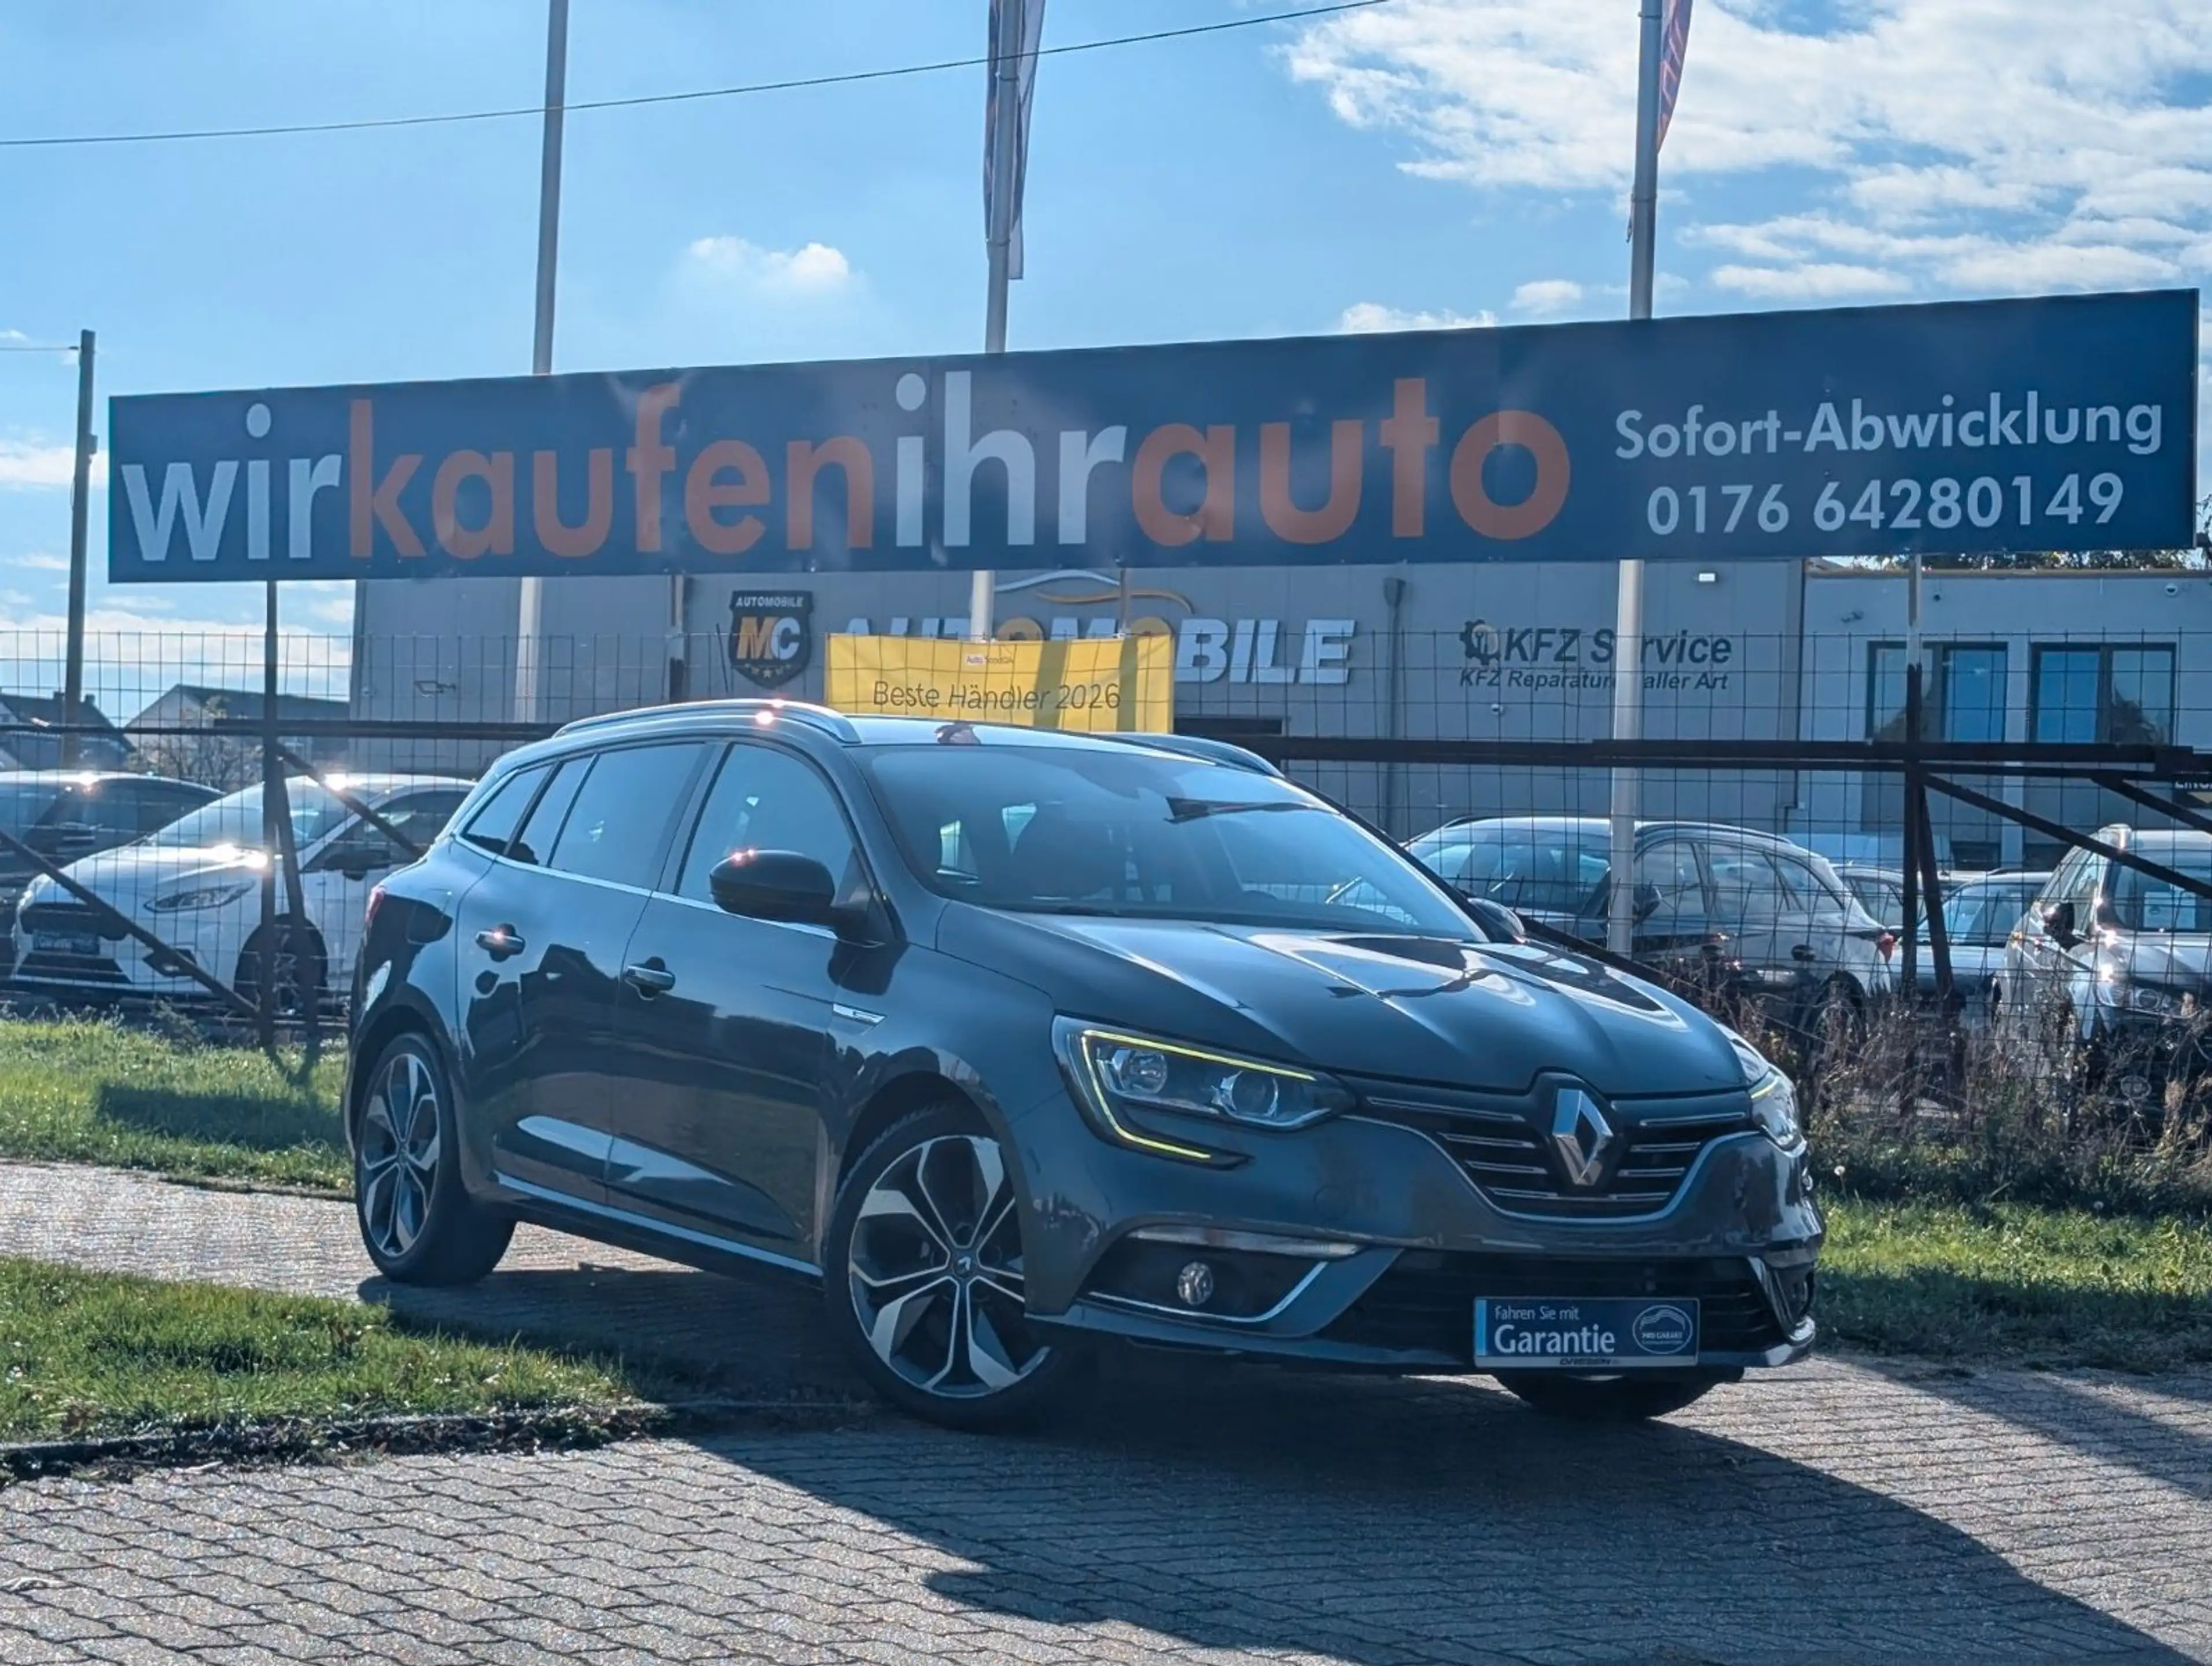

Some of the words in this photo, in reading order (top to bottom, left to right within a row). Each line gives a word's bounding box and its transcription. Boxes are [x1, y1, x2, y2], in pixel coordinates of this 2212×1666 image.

[1615, 390, 2162, 459] Sofort-Abwicklung
[1647, 484, 1790, 535] 0176
[1813, 472, 2124, 532] 64280149
[735, 595, 804, 607] AUTOMOBILE
[737, 616, 801, 660] MC
[1505, 628, 1581, 662] KFZ
[1590, 628, 1732, 664] Srvice
[873, 681, 940, 707] Beste
[948, 684, 1051, 710] Händler
[1055, 683, 1121, 709] 2026
[1460, 669, 1501, 687] KFZ
[1507, 669, 1616, 691] Reparatur
[1643, 671, 1691, 690] aller
[1694, 671, 1729, 690] Art
[1494, 1304, 1536, 1321] Fahren
[1539, 1305, 1557, 1320] Sie
[1559, 1305, 1580, 1321] mit
[1494, 1323, 1615, 1354] Garantie
